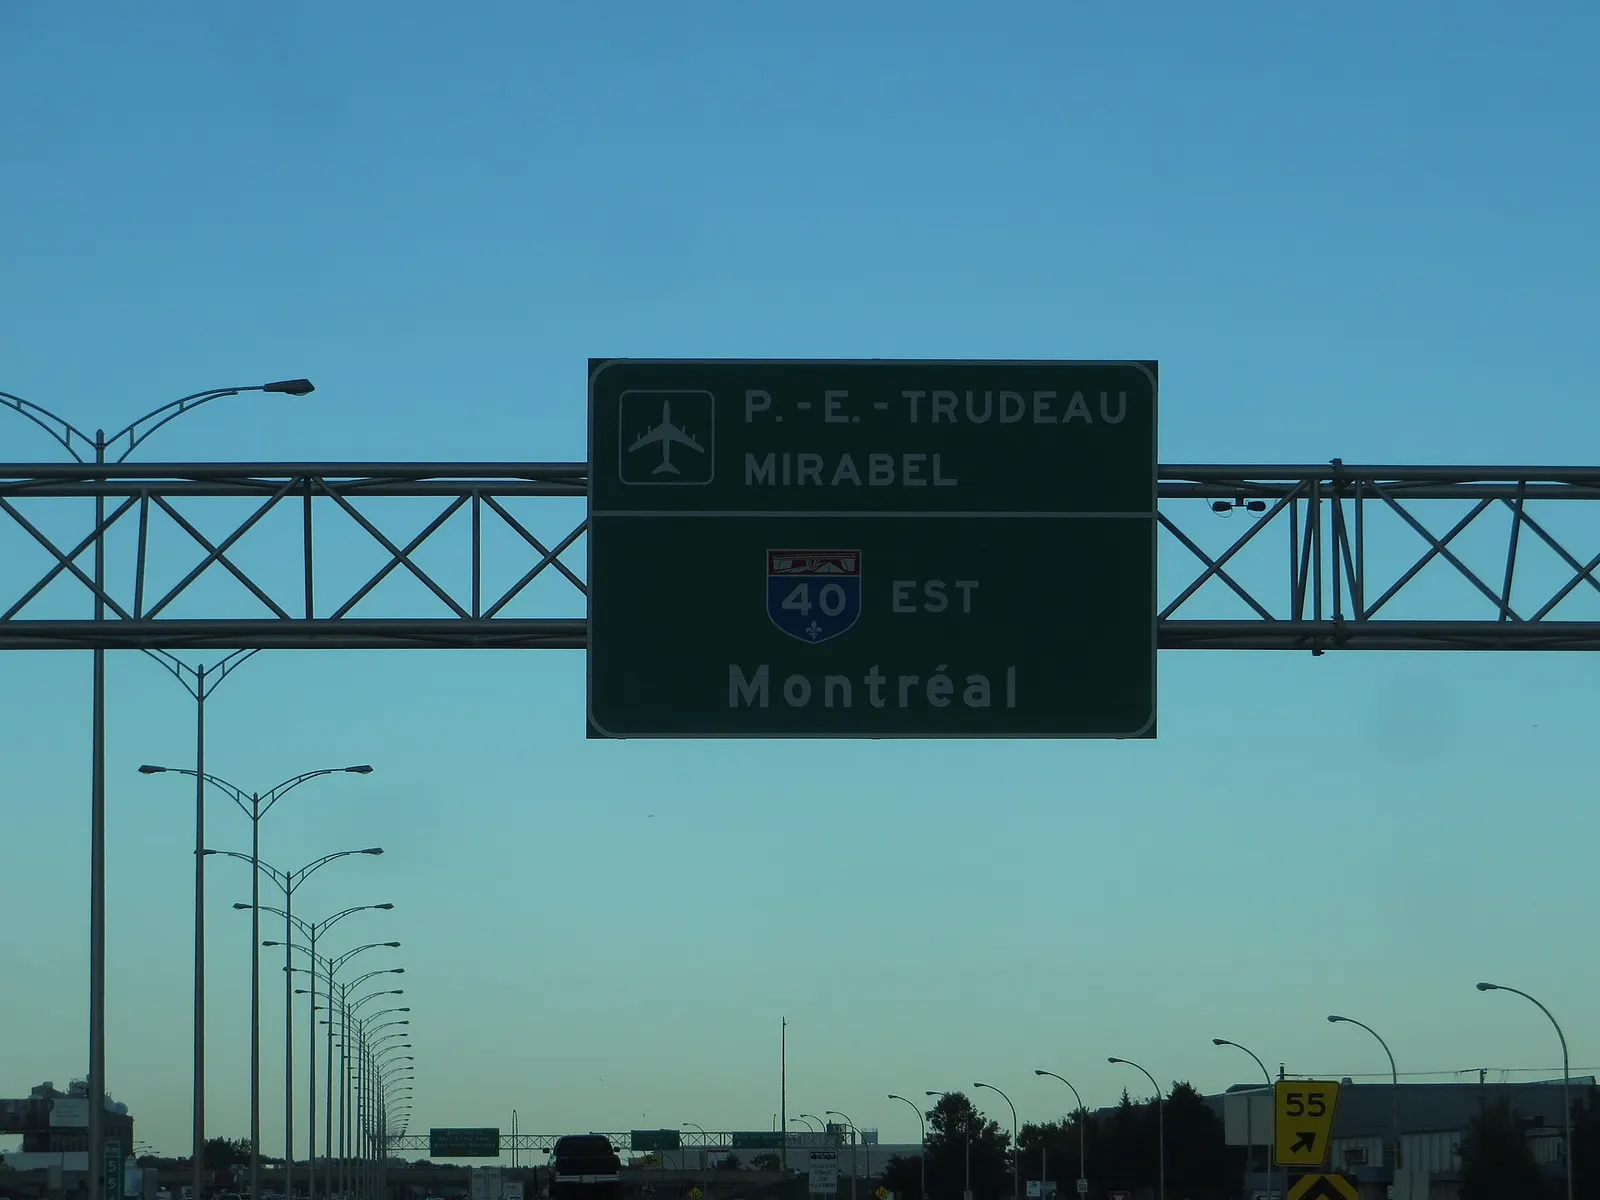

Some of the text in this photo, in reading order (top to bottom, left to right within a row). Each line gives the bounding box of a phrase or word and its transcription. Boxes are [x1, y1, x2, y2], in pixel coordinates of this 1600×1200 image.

[744, 452, 958, 486] MIRABEL
[781, 580, 979, 615] 40 EST
[728, 663, 1016, 708] Montréal
[1286, 1092, 1326, 1118] 55
